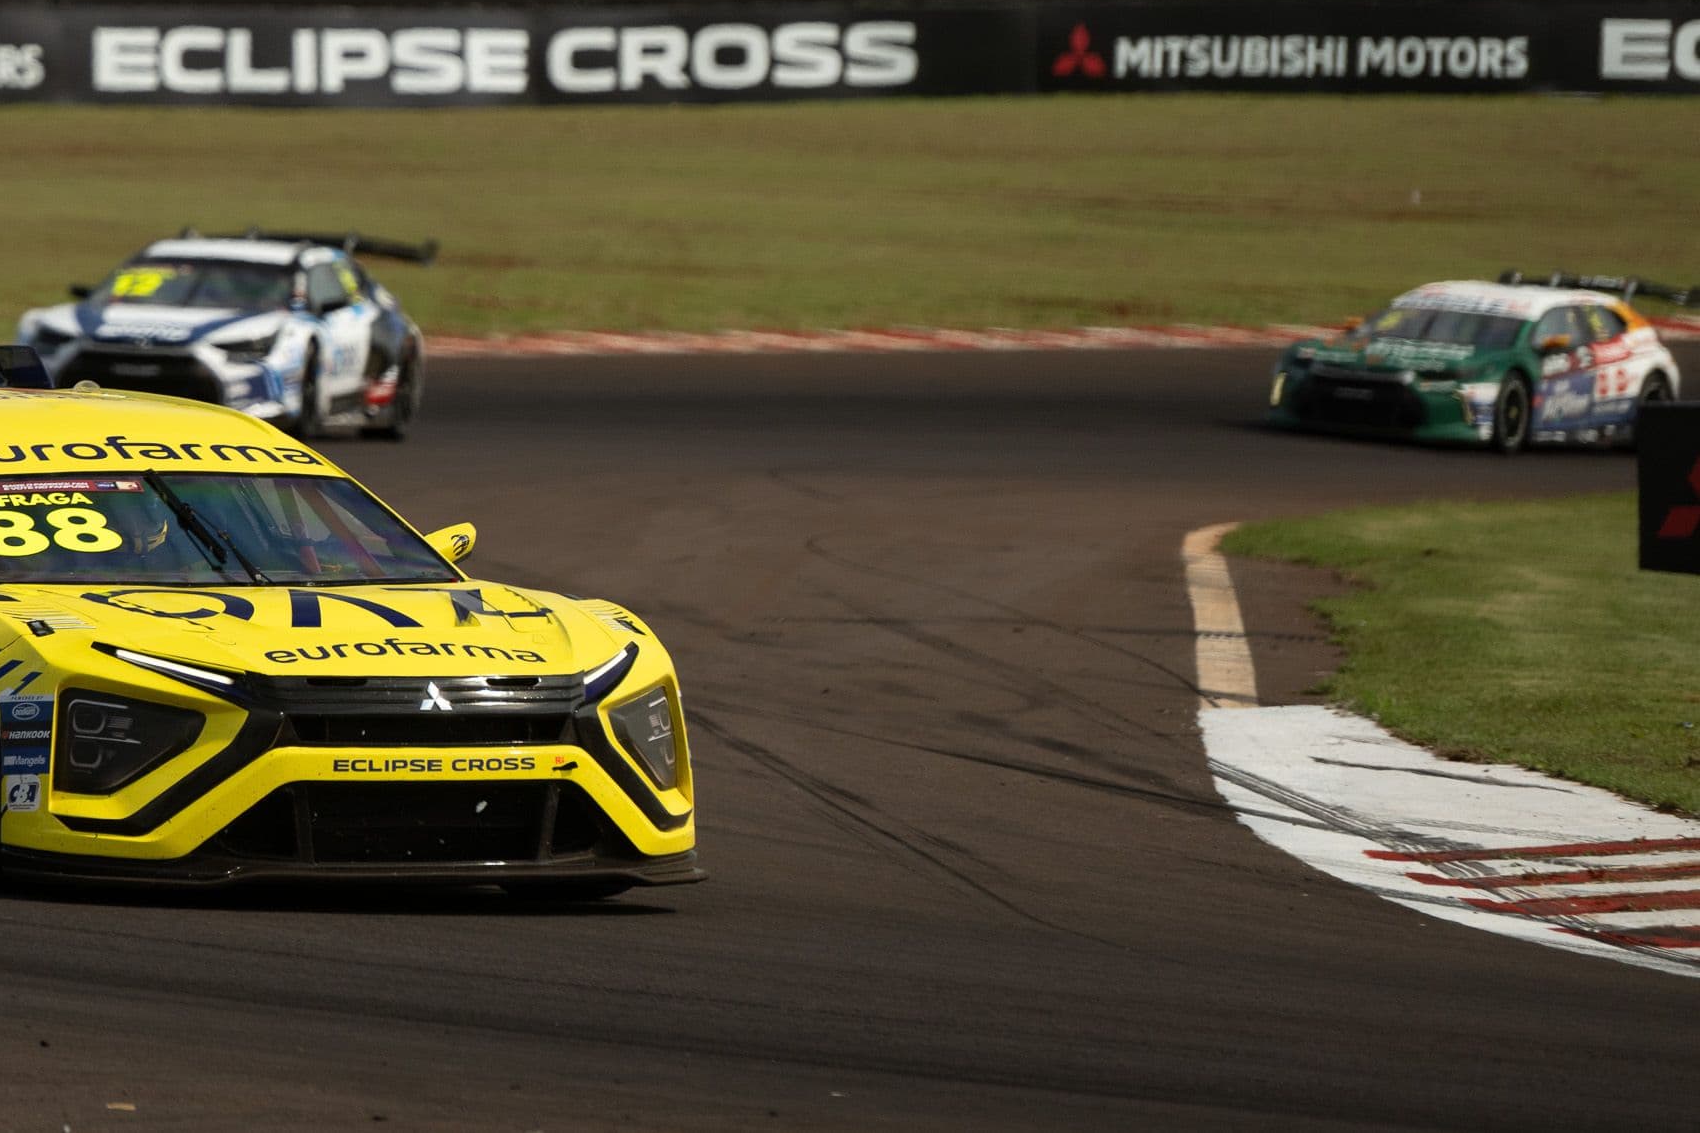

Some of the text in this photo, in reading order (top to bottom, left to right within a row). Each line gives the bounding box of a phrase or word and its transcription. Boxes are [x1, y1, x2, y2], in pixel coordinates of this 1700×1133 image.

[92, 20, 919, 95] ECLIPSE CROSS
[1113, 35, 1529, 79] MITSUBISHI MOTORS
[263, 637, 548, 664] eurofarma
[332, 756, 536, 773] ECLIPSE CROSS
